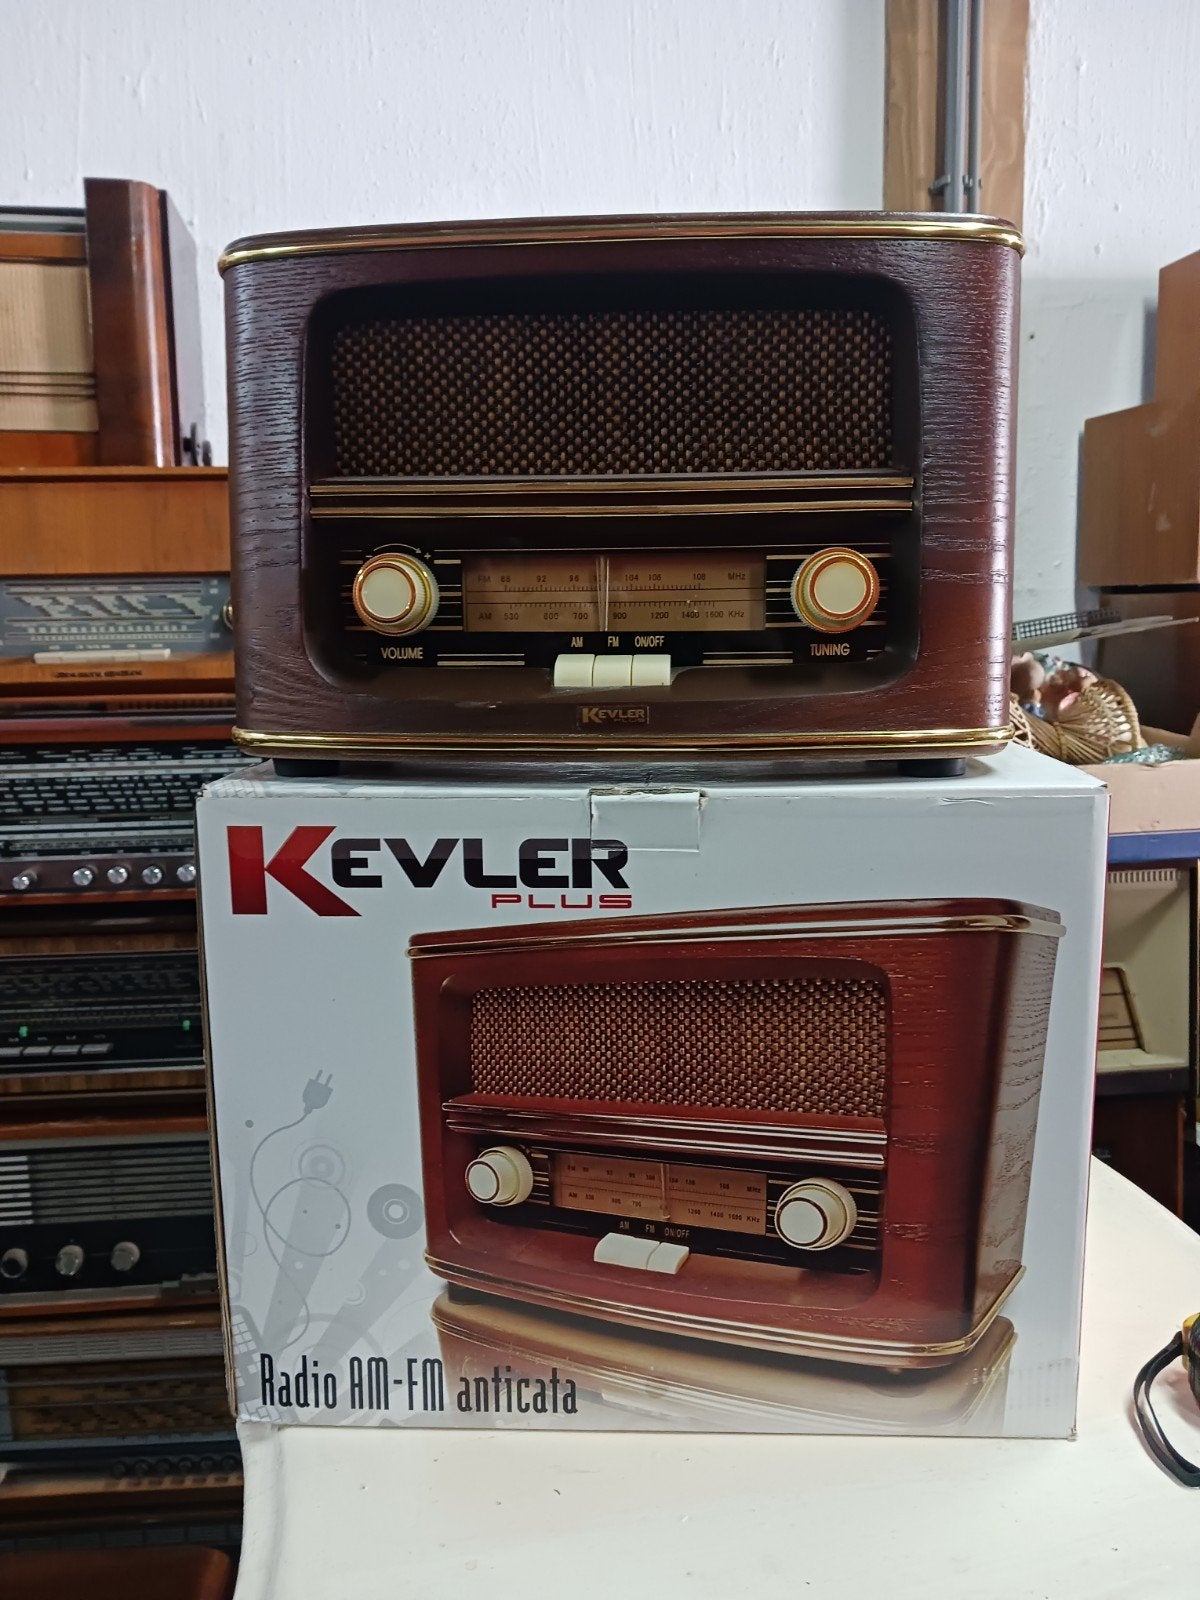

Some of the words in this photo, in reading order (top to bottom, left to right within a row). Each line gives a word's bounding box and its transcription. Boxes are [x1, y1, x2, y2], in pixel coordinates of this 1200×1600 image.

[648, 573, 662, 581] 106
[728, 572, 746, 580] MHz
[480, 612, 492, 620] AM
[504, 612, 519, 620] 530
[573, 612, 588, 620] 700
[612, 612, 627, 620] 900
[681, 611, 700, 619] 1400
[705, 610, 724, 618] 1600
[728, 610, 745, 618] KHz
[571, 636, 584, 648] AM
[607, 636, 619, 647] FM
[634, 635, 665, 648] ON/OFF
[380, 646, 424, 660] VOLUME
[809, 642, 851, 657] TUNING
[582, 707, 646, 723] KEVLER
[226, 825, 630, 917] KEVLER
[491, 894, 633, 909] PLUS
[746, 1215, 760, 1223] KHz
[619, 1220, 630, 1230] AM
[645, 1224, 656, 1234] FM
[664, 1226, 690, 1239] ON/OFF
[260, 1353, 338, 1410] Radio
[350, 1356, 445, 1412] AM-FM
[457, 1365, 578, 1414] anticata
